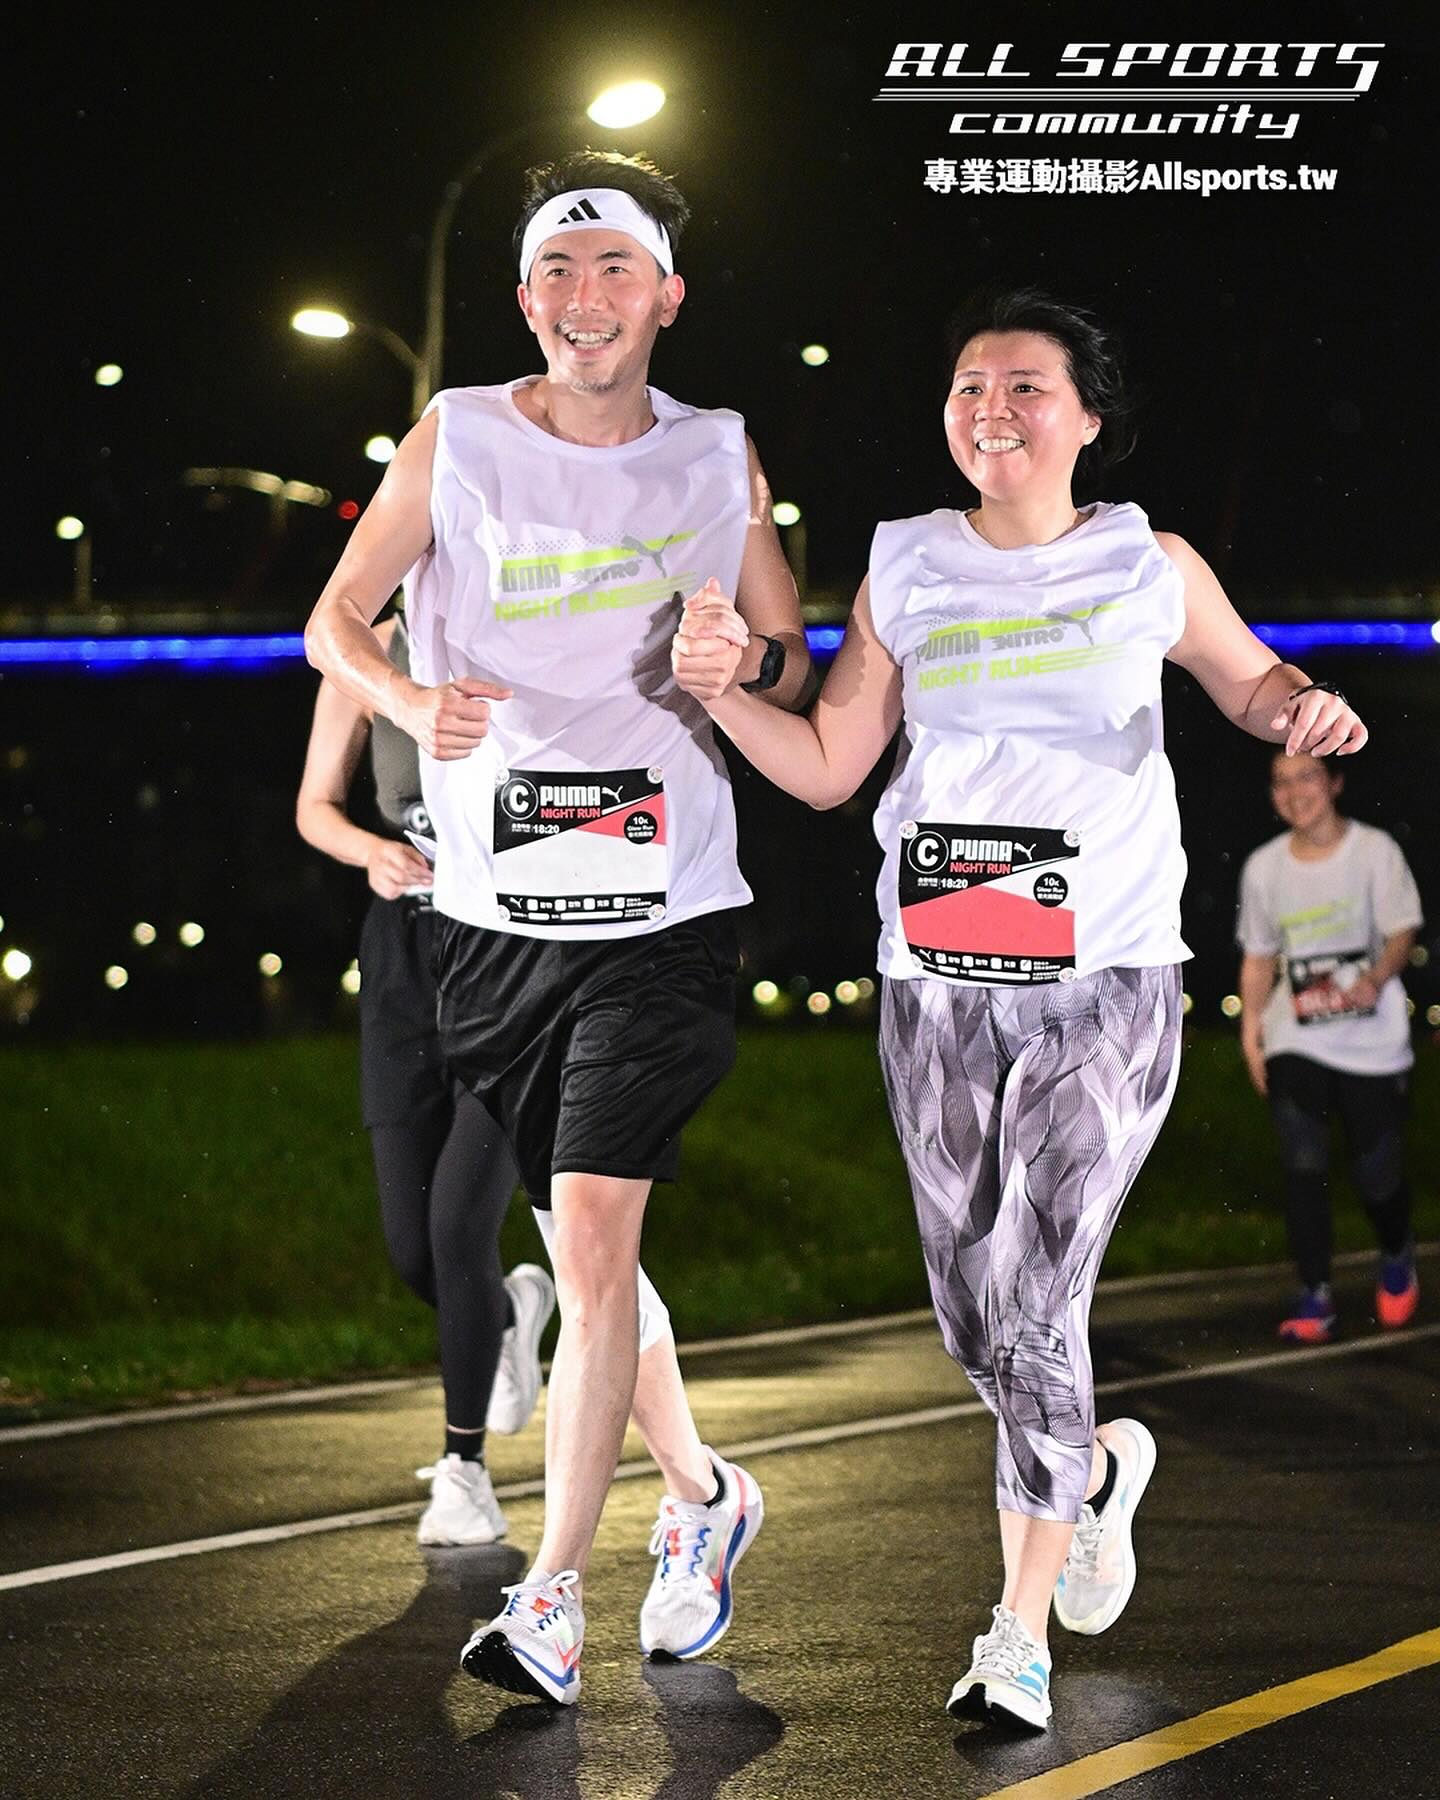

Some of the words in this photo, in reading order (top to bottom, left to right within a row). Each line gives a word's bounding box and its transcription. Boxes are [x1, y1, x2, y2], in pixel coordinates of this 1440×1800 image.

[919, 662, 983, 692] NIGHT
[991, 656, 1041, 681] RUN
[509, 784, 530, 813] C
[540, 786, 601, 806] PUMA
[540, 807, 575, 819] NIGHT
[577, 808, 601, 819] RUN
[533, 824, 560, 834] 18:20
[917, 838, 939, 867] C
[951, 839, 1013, 862] PUMA
[950, 862, 985, 874] NIGHT
[987, 863, 1012, 874] RUN
[941, 877, 968, 889] 18:20
